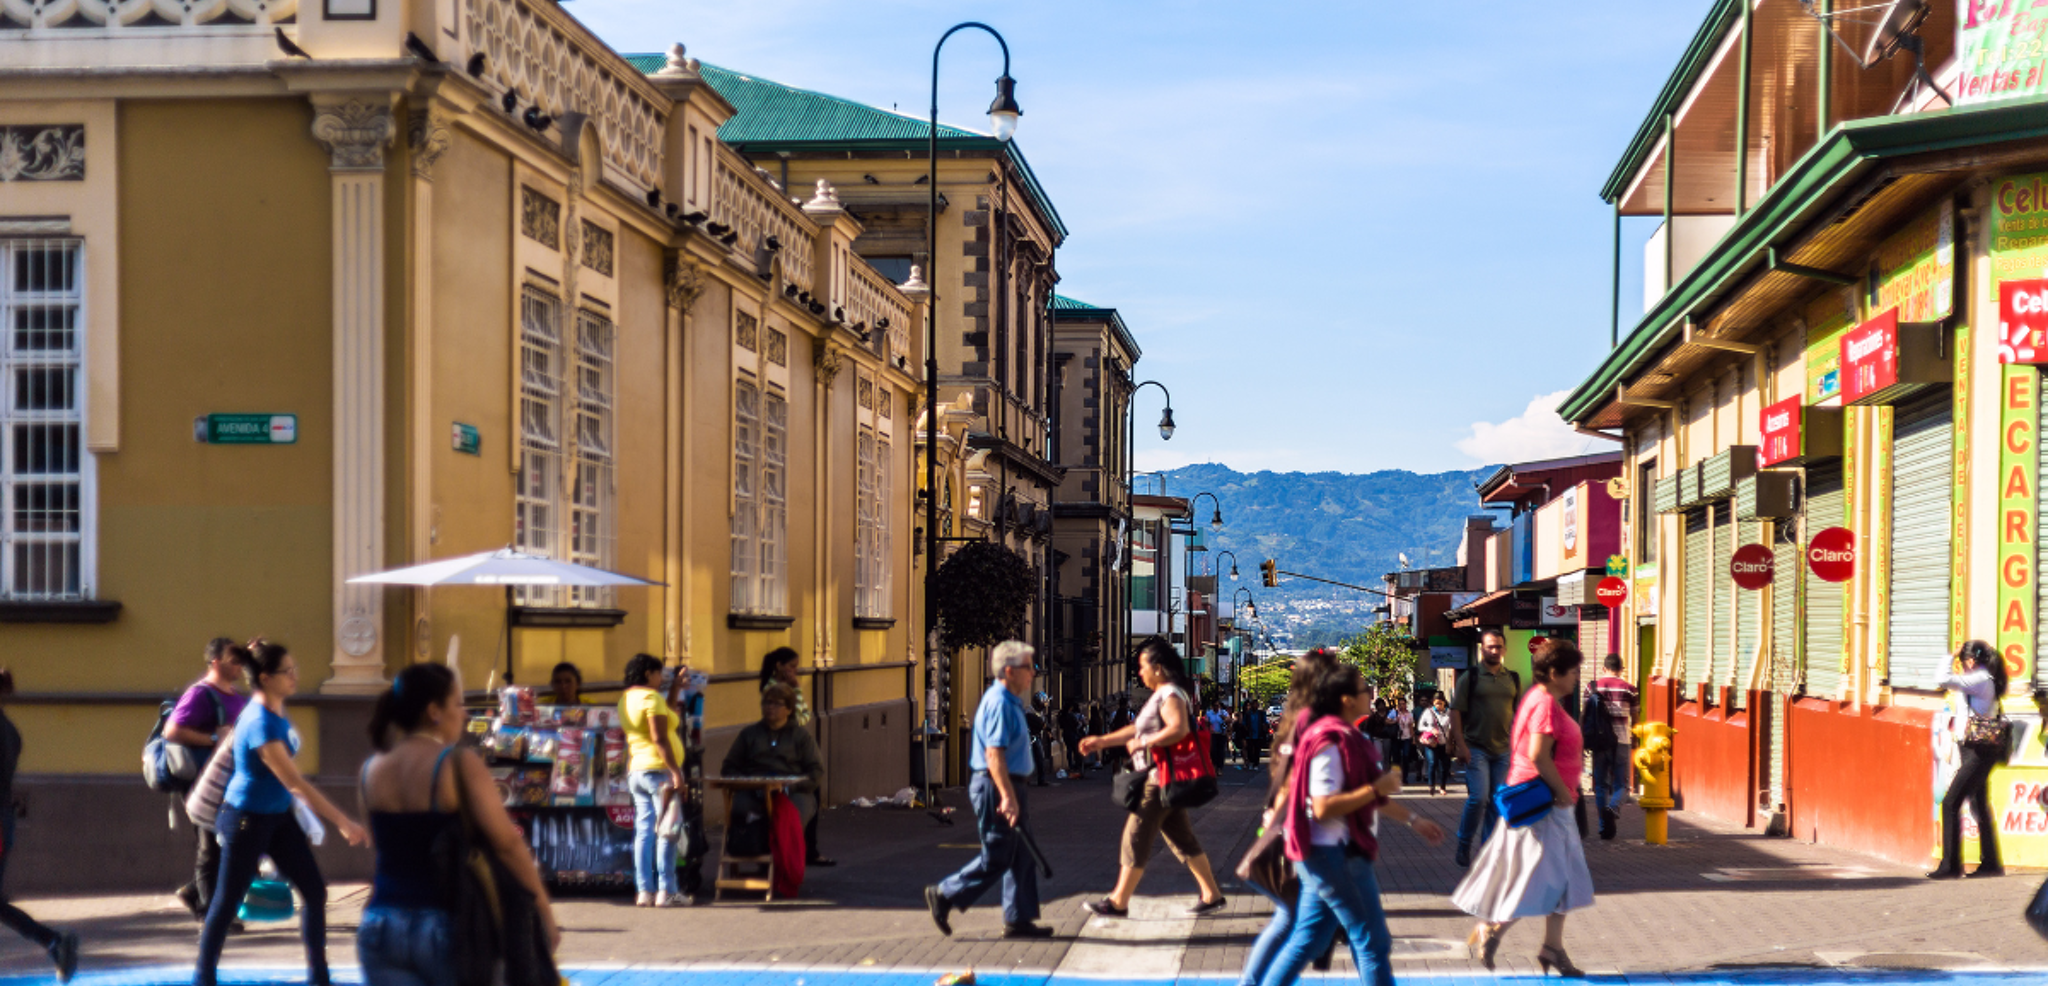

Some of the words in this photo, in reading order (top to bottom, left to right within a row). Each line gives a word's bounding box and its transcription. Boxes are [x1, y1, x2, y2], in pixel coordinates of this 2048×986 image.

[1959, 67, 2021, 98] Ventas
[2025, 59, 2046, 87] al
[1996, 255, 2026, 275] Pagos
[1957, 337, 1967, 433] VENTA
[216, 422, 260, 434] AVENIDA
[1957, 450, 1965, 485] DE
[1809, 541, 1854, 563] Claro
[1732, 560, 1768, 573] Claro
[1597, 588, 1622, 596] Claro
